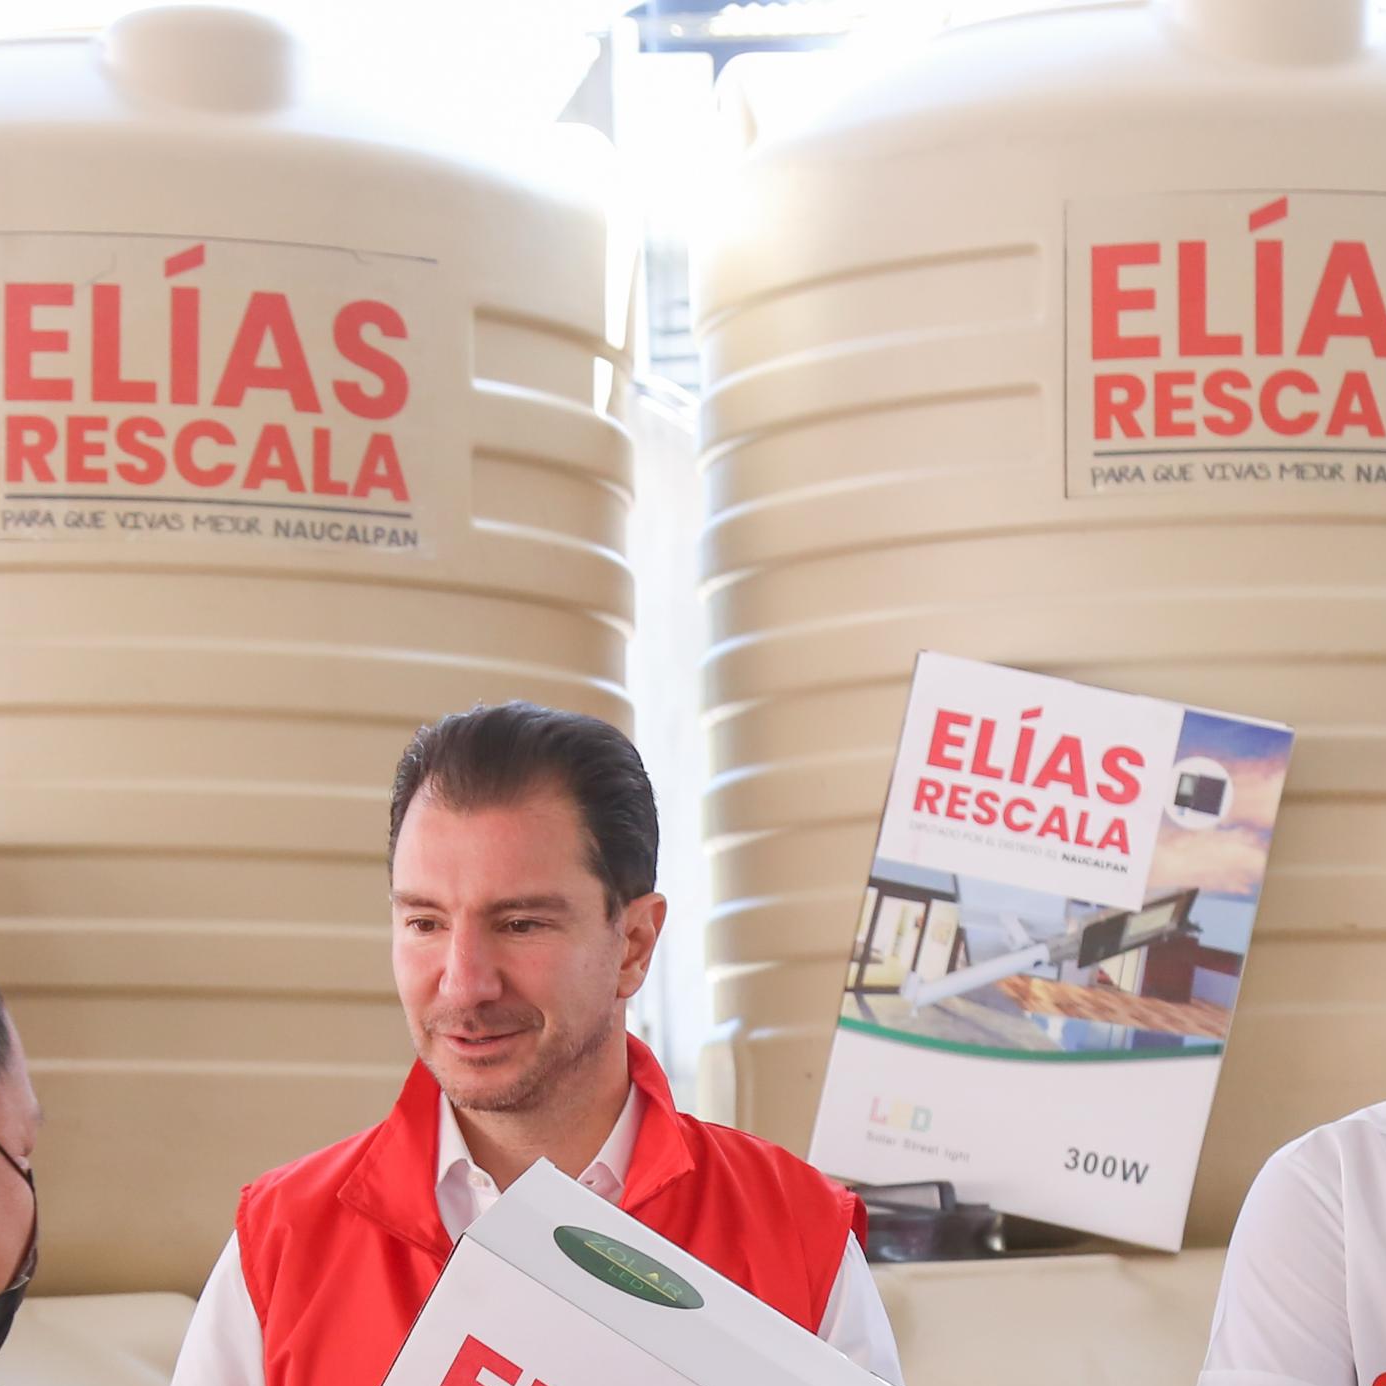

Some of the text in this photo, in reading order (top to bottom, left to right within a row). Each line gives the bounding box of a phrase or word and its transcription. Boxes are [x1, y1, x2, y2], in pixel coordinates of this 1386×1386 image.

[4, 243, 409, 420] ELÍAS
[5, 415, 410, 502] RESCALA
[1091, 465, 1145, 487] PARA
[1153, 463, 1193, 483] QUE
[1202, 462, 1271, 481] VIVAS
[1280, 462, 1345, 482] MEJOR
[2, 509, 418, 548] PARA QUE VIVAS MEJOR NAUCALPAN
[927, 707, 1145, 805] ELÍAS
[914, 777, 1131, 856] RESCALA
[1062, 853, 1129, 874] NAUCALPAN
[1064, 1147, 1150, 1186] 300W
[608, 1265, 644, 1290] LED
